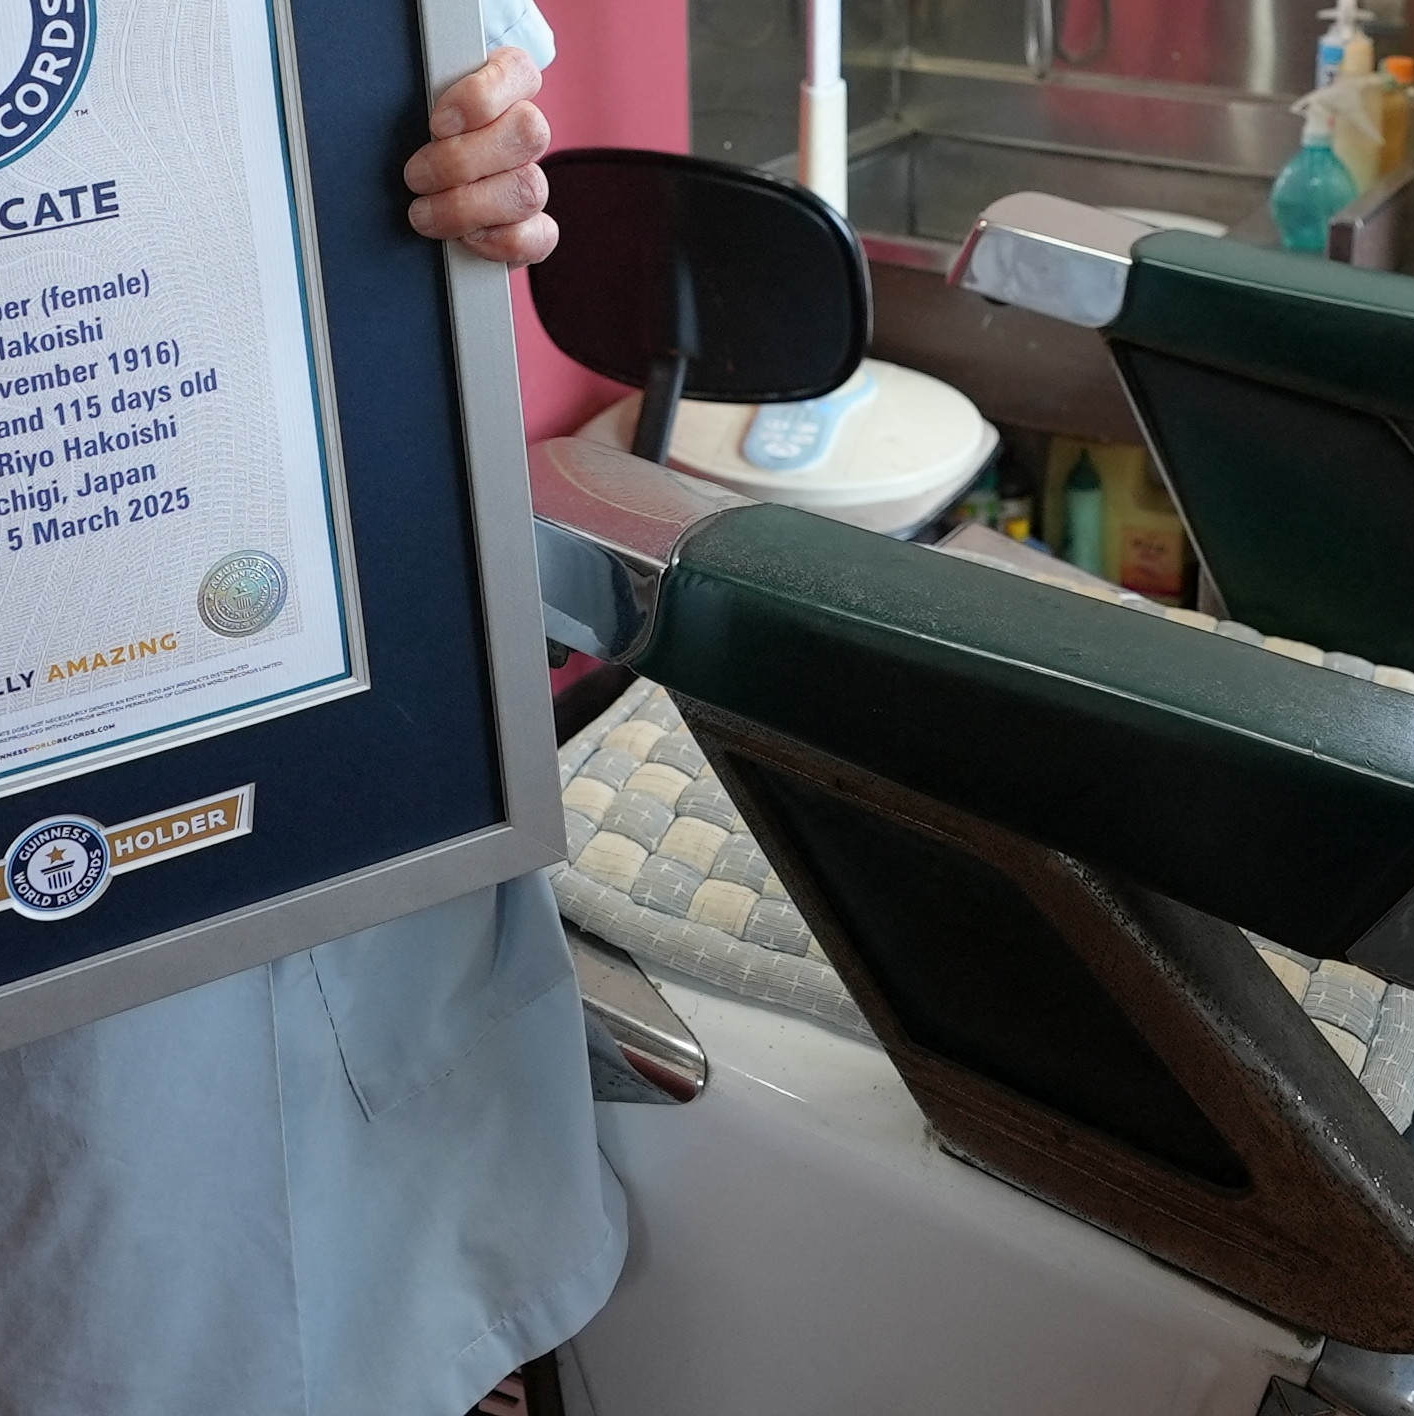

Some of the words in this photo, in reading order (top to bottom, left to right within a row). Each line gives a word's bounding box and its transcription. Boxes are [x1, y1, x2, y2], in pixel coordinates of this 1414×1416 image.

[41, 268, 150, 318] (female)
[108, 338, 180, 375] 1916)
[53, 394, 102, 426] 115
[111, 385, 172, 414] days
[180, 367, 218, 398] old
[63, 414, 177, 463] Hakoishi
[76, 463, 157, 498] Japan
[7, 526, 23, 552] 5
[32, 506, 119, 546] March
[128, 486, 190, 524] 2025
[47, 632, 179, 684] AMAZING
[18, 825, 91, 862] GUINNESS
[114, 807, 228, 859] HOLDER
[12, 871, 53, 908] WORLD
[56, 848, 102, 906] RECORDS
